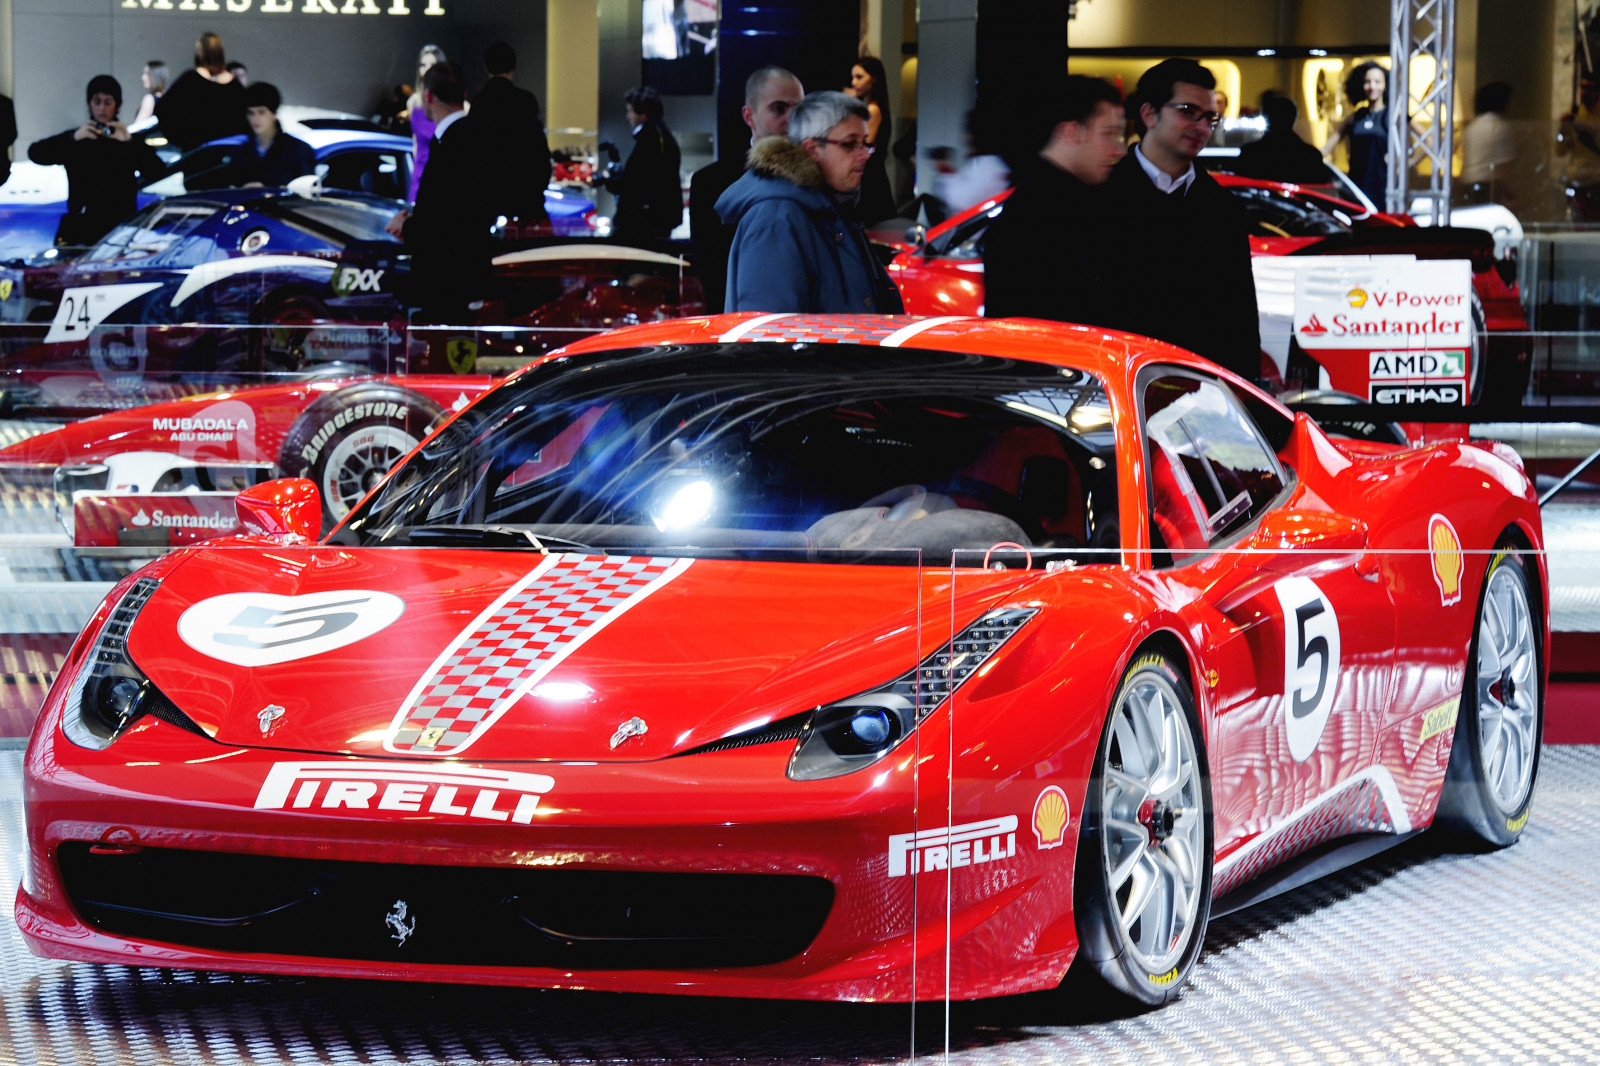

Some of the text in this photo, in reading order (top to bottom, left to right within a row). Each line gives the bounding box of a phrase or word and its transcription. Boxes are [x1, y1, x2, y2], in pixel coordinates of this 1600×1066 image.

[338, 267, 385, 292] FXX
[1373, 292, 1465, 307] V-Power
[64, 296, 91, 332] 24
[1333, 312, 1465, 336] Santander
[1372, 355, 1438, 375] AMD
[1375, 388, 1459, 404] ETIHAD
[153, 417, 248, 431] MUBADALA
[301, 402, 409, 466] BRIDGESTONE
[170, 431, 233, 442] ABU DHABI
[151, 509, 237, 529] Santander
[212, 597, 372, 648] 5
[1292, 597, 1329, 719] 5
[254, 761, 555, 825] PIRELLI
[888, 814, 1018, 877] PIRELLI
